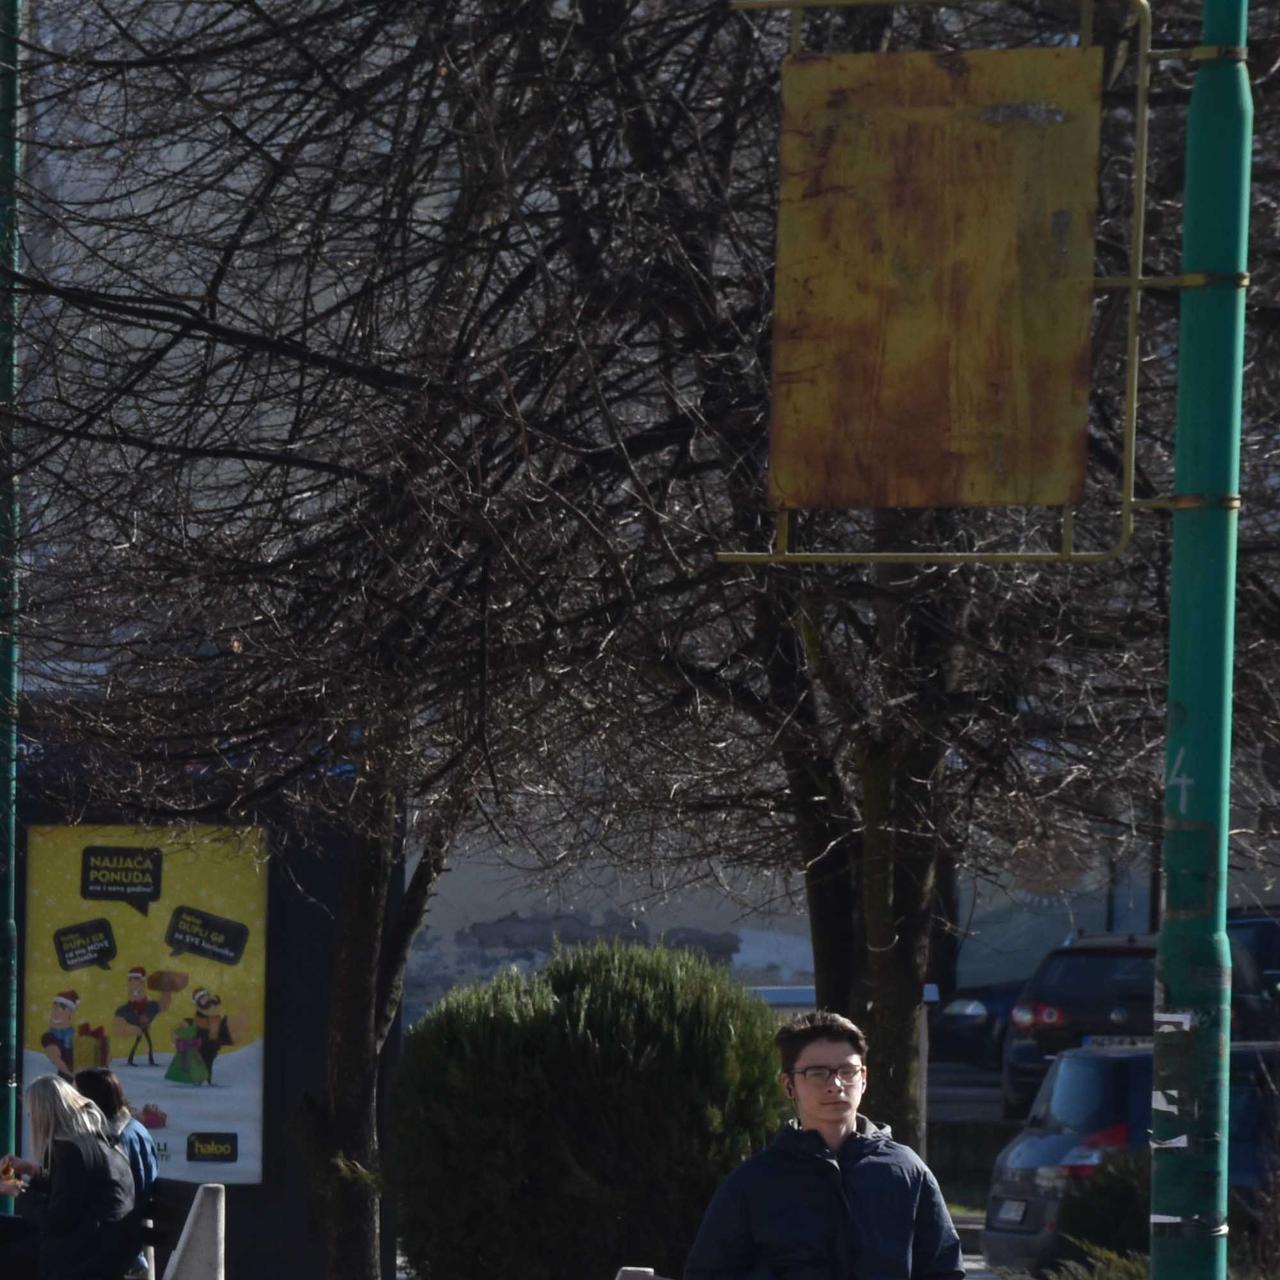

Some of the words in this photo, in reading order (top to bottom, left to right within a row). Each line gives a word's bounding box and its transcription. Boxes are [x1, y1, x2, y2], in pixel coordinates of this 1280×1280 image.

[1167, 746, 1194, 815] 4
[90, 855, 153, 869] NAJJAČA
[90, 870, 153, 883] PONUDA
[195, 1140, 231, 1154] haloo
